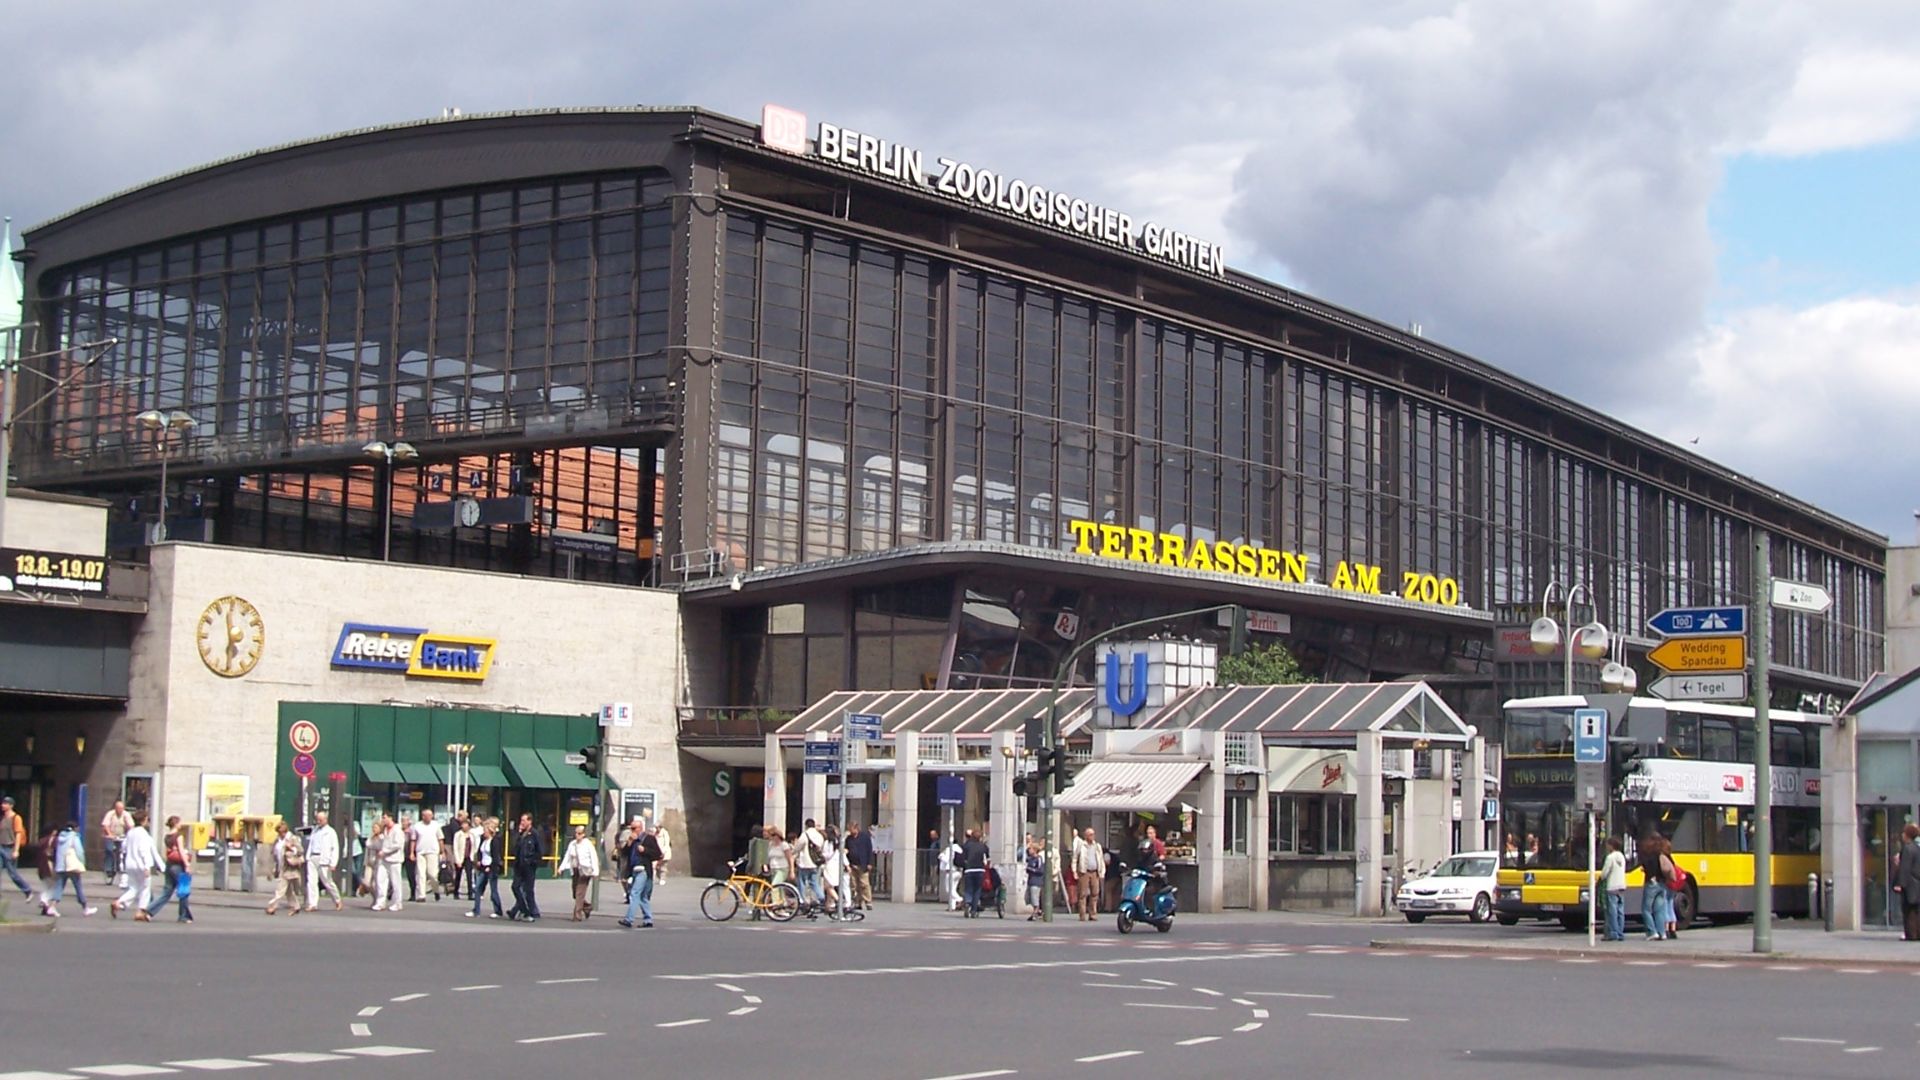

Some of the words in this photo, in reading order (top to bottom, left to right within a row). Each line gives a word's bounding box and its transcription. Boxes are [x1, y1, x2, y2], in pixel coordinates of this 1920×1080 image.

[770, 113, 801, 147] DB
[818, 121, 923, 185] BERLIN
[937, 156, 1134, 250] ZOOLOGISCHER
[1143, 221, 1226, 278] GARTEN
[432, 475, 441, 488] 2
[471, 472, 481, 486] A
[1070, 519, 1309, 584] TERRASSEN
[1331, 559, 1382, 595] AM
[1402, 571, 1459, 606] ZOO
[1800, 591, 1812, 602] Zoo
[1676, 617, 1690, 628] 100
[342, 632, 413, 659] Reise
[421, 642, 481, 669] Bank
[1680, 642, 1726, 655] Wedding
[1681, 655, 1727, 667] Spandau
[1105, 652, 1148, 716] U
[1697, 681, 1726, 695] Tegel
[715, 770, 730, 797] S
[1486, 800, 1495, 818] U
